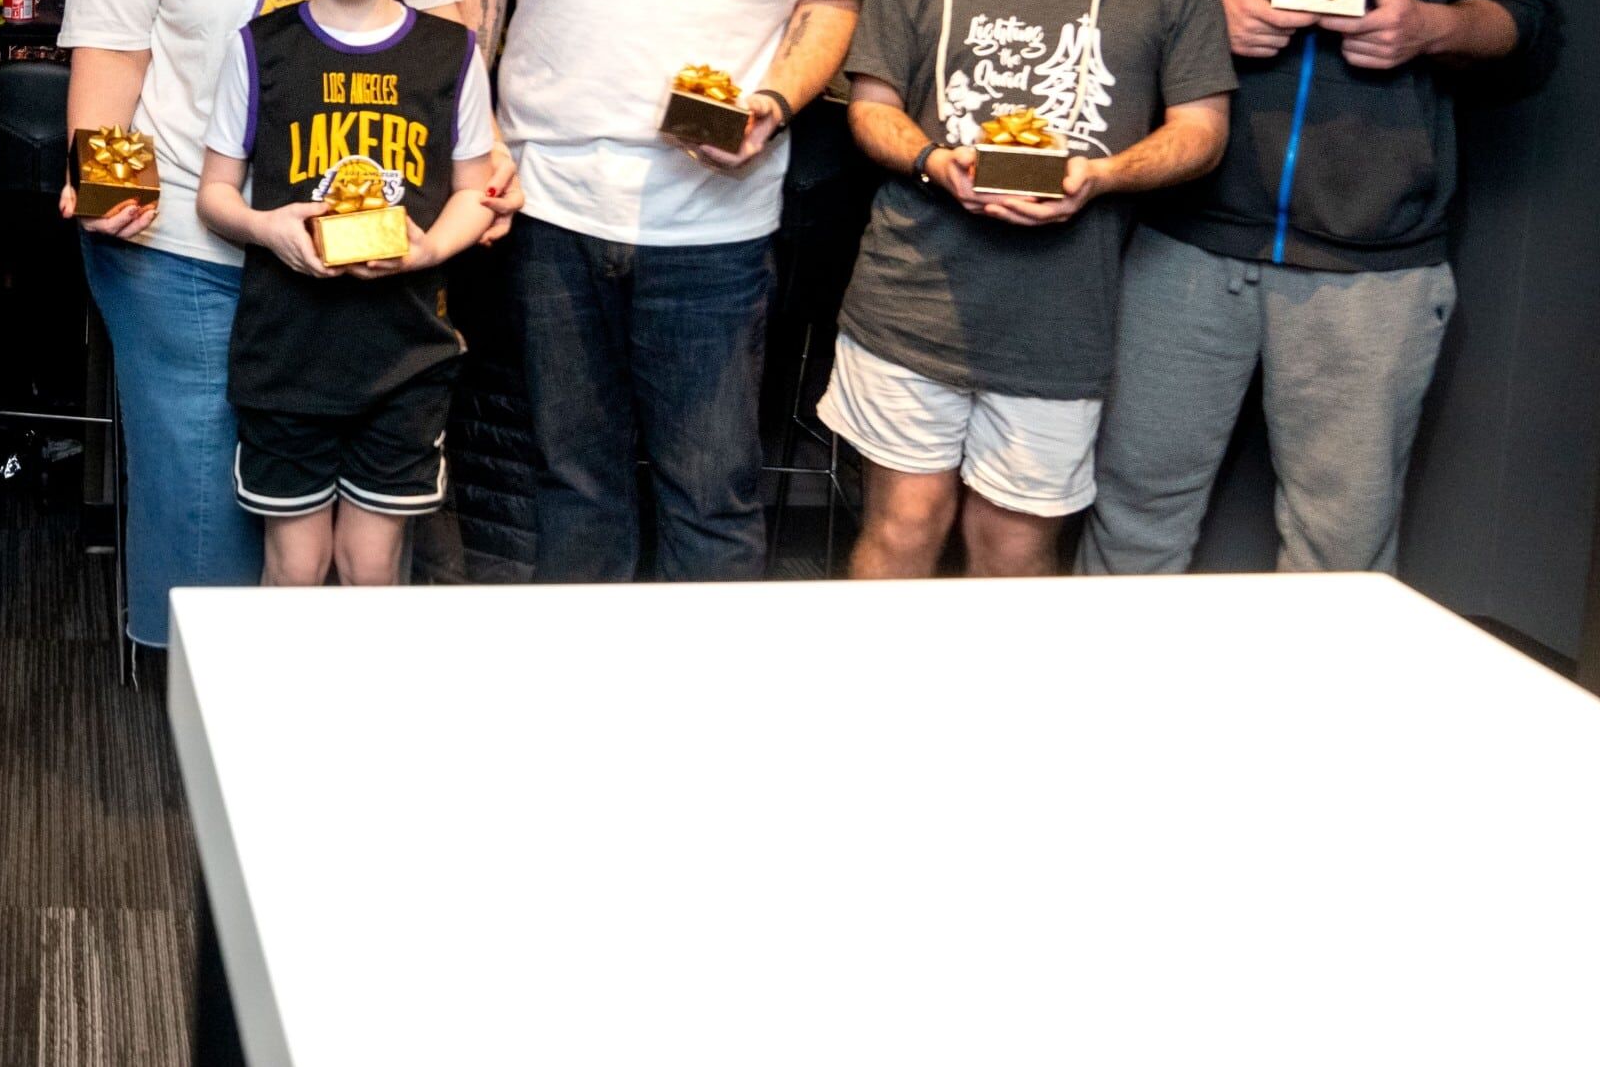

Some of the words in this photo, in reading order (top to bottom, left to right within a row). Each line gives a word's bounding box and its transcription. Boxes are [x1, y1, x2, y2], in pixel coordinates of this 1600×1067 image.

[323, 72, 345, 103] LOS
[350, 72, 398, 105] ANGELES
[974, 59, 1031, 98] Quad
[289, 111, 428, 187] LAKERS
